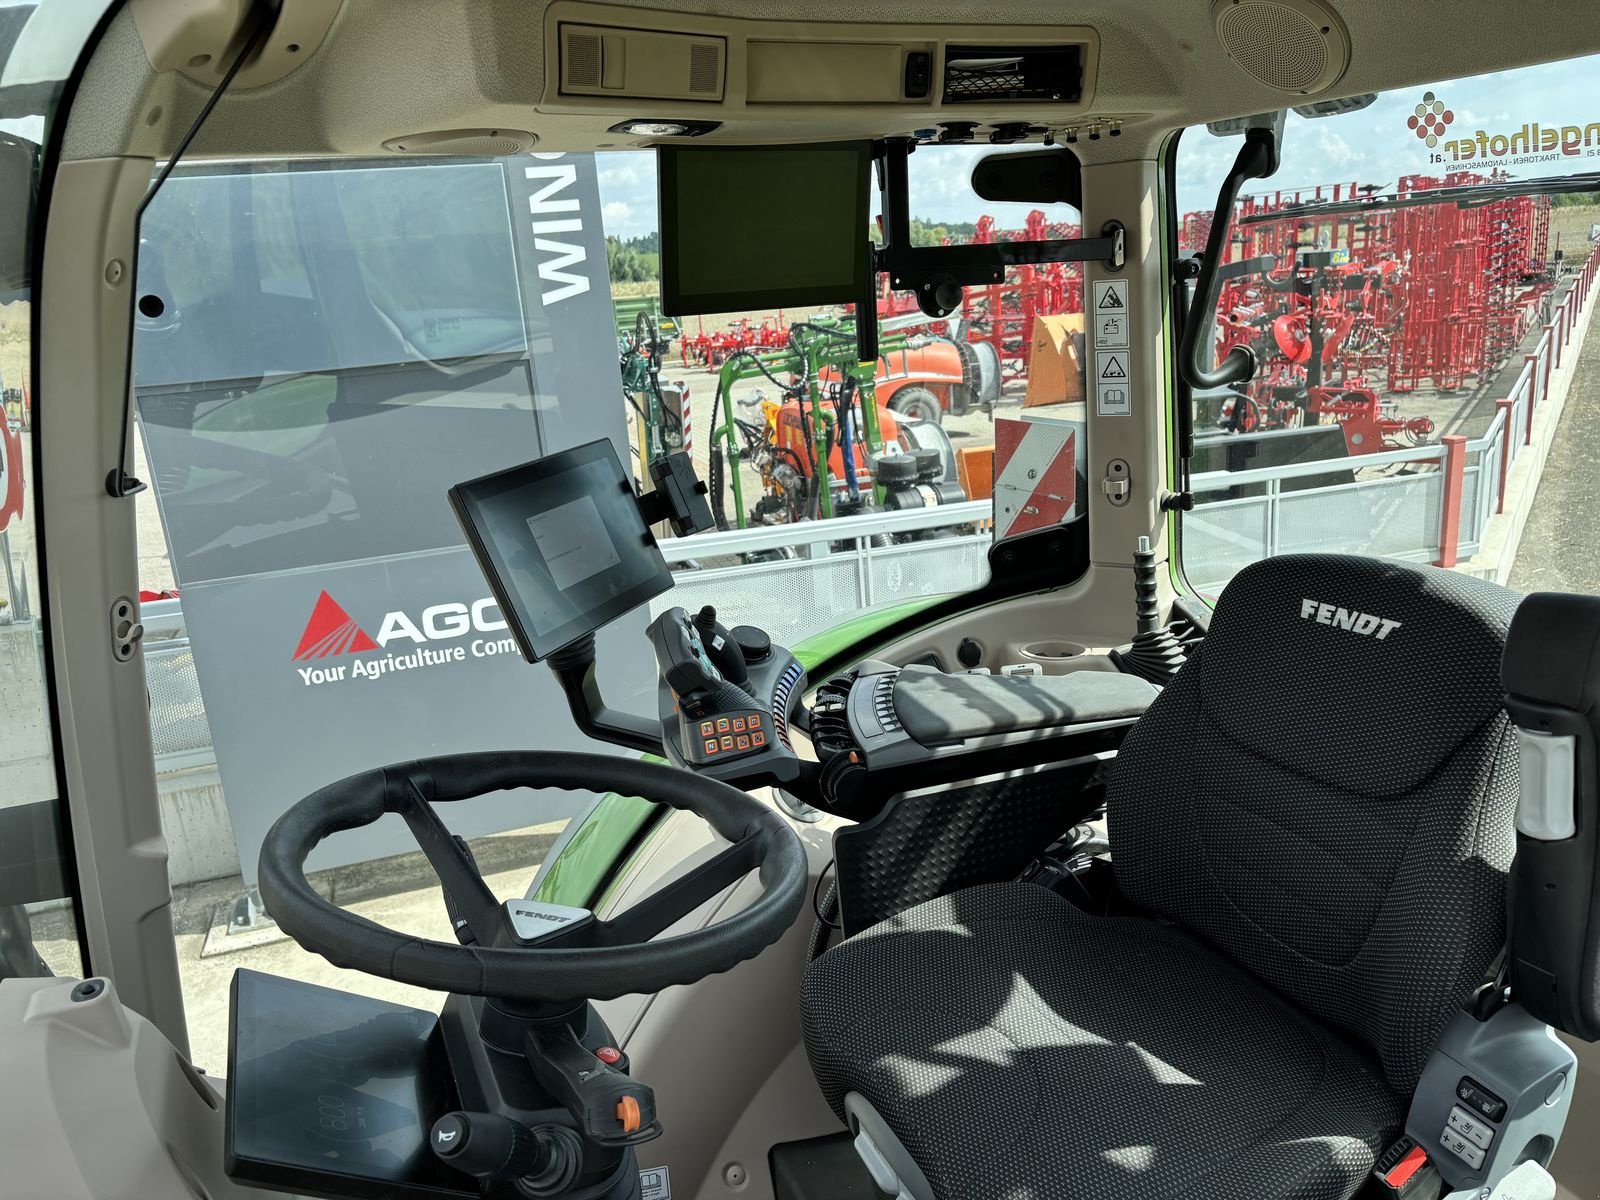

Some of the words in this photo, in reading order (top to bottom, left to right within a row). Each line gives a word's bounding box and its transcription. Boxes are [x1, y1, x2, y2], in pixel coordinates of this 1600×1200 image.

[524, 152, 590, 306] WIN
[1300, 598, 1402, 640] FENDT
[297, 666, 346, 686] Your
[352, 647, 466, 680] Agriculture
[471, 638, 521, 658] Com
[515, 909, 572, 923] FENDT
